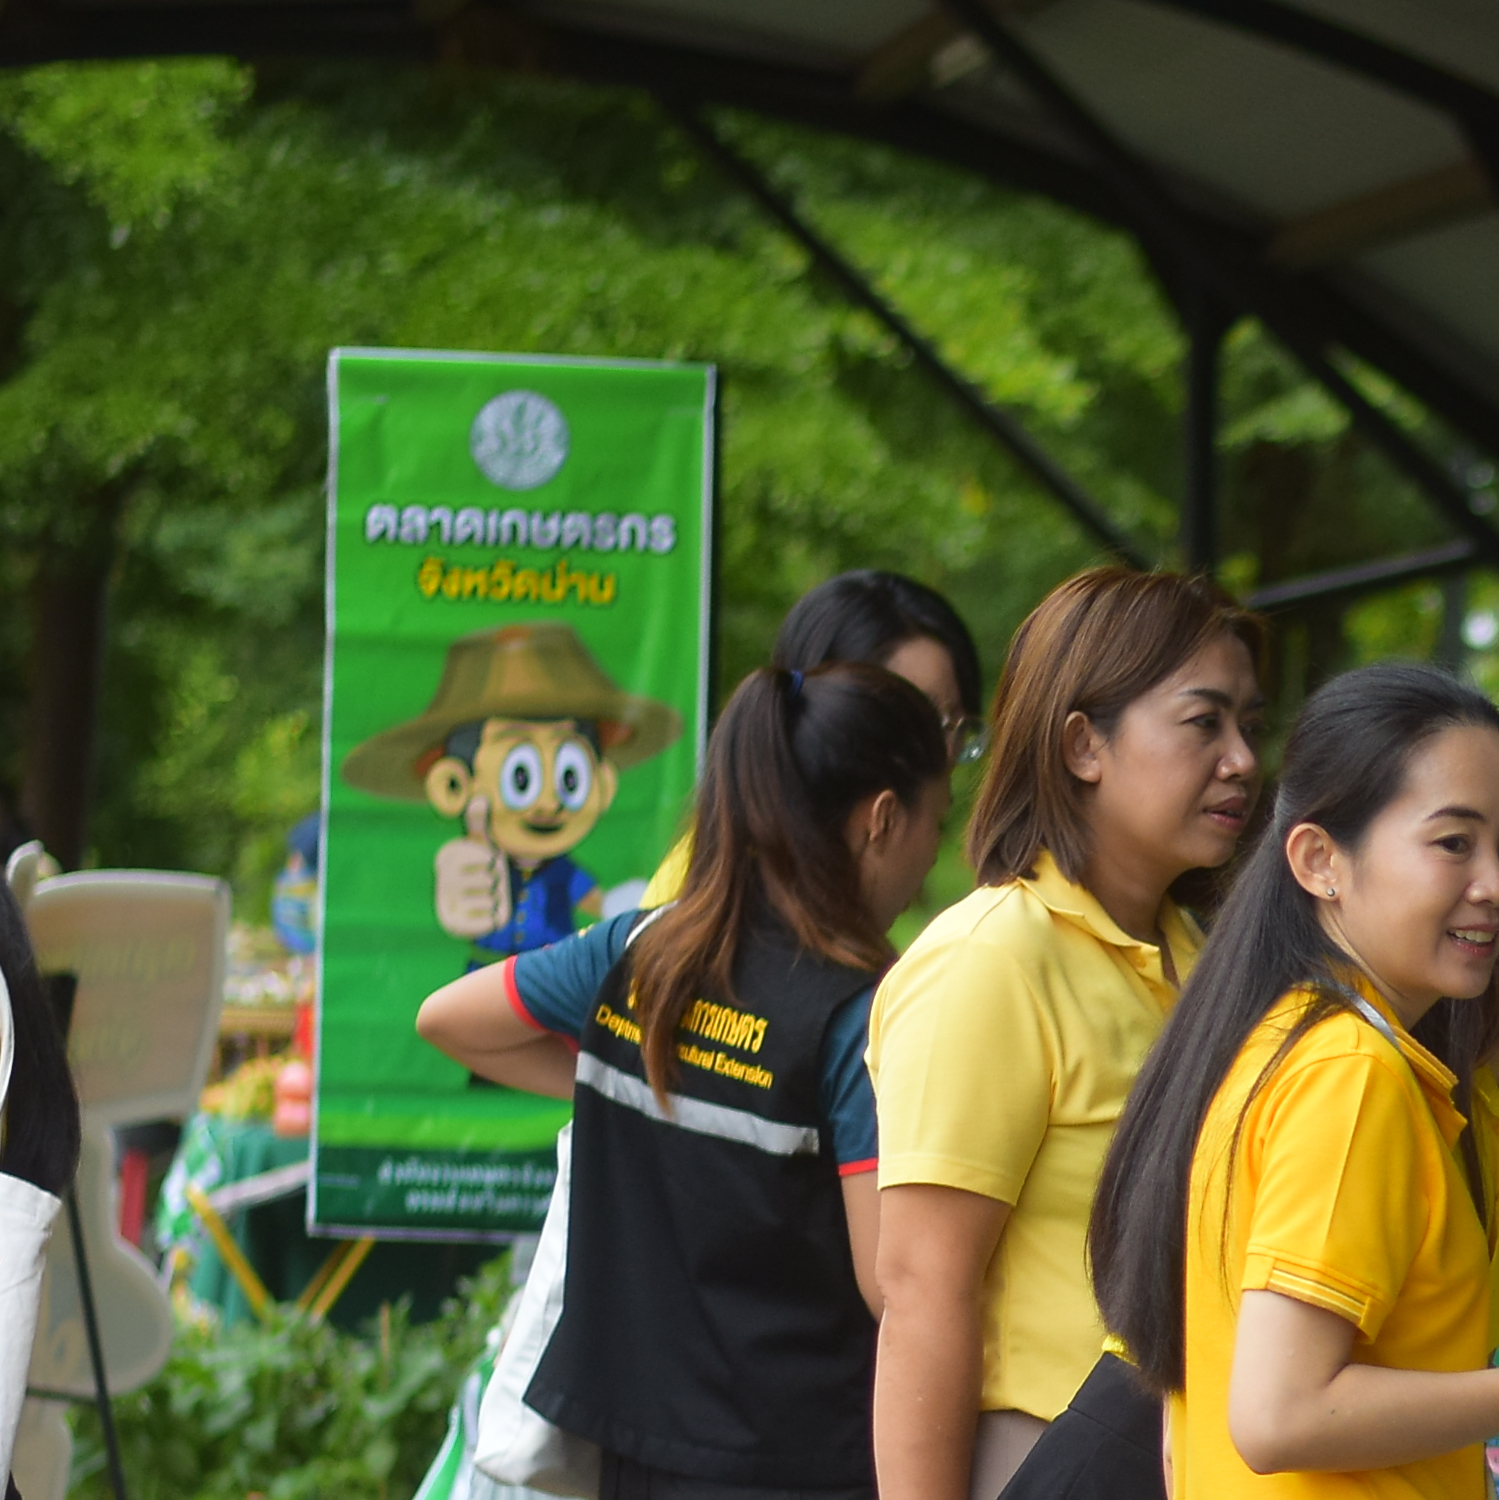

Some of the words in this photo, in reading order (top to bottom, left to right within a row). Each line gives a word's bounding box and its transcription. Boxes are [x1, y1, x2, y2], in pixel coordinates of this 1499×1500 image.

[364, 503, 676, 555] ตลาดเกษตรกร
[418, 557, 615, 604] จังหวัดน่าน
[714, 1052, 774, 1090] Extension
